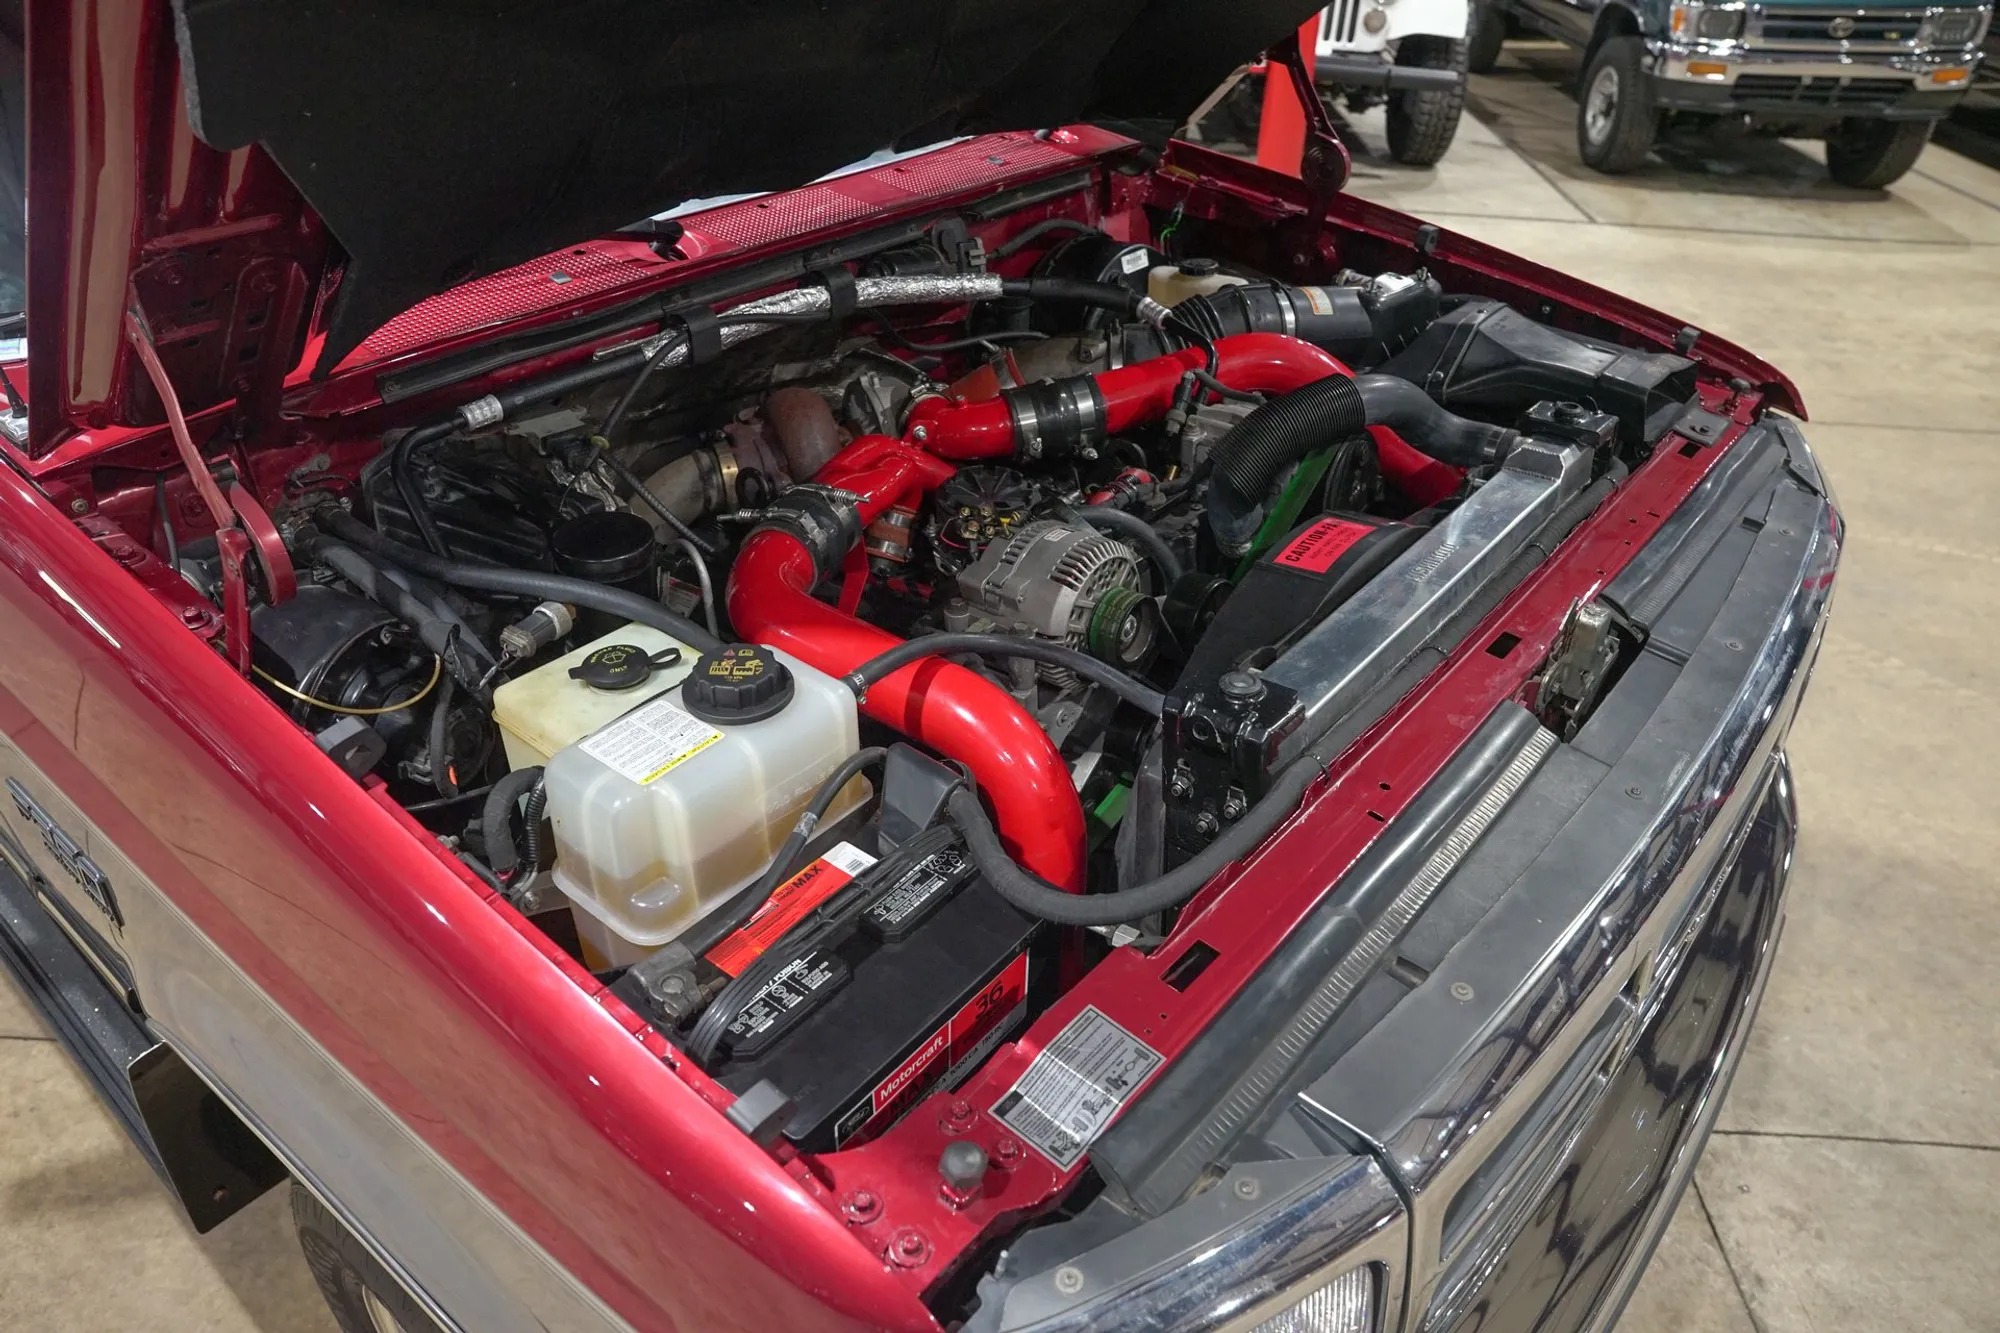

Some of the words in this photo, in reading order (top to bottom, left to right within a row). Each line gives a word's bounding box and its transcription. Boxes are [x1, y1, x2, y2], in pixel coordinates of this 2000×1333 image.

[610, 665, 628, 674] ONLY
[792, 864, 823, 889] MAX
[774, 959, 803, 983] POISON
[975, 981, 1004, 1020] 36
[880, 1036, 943, 1101] Motorcraft
